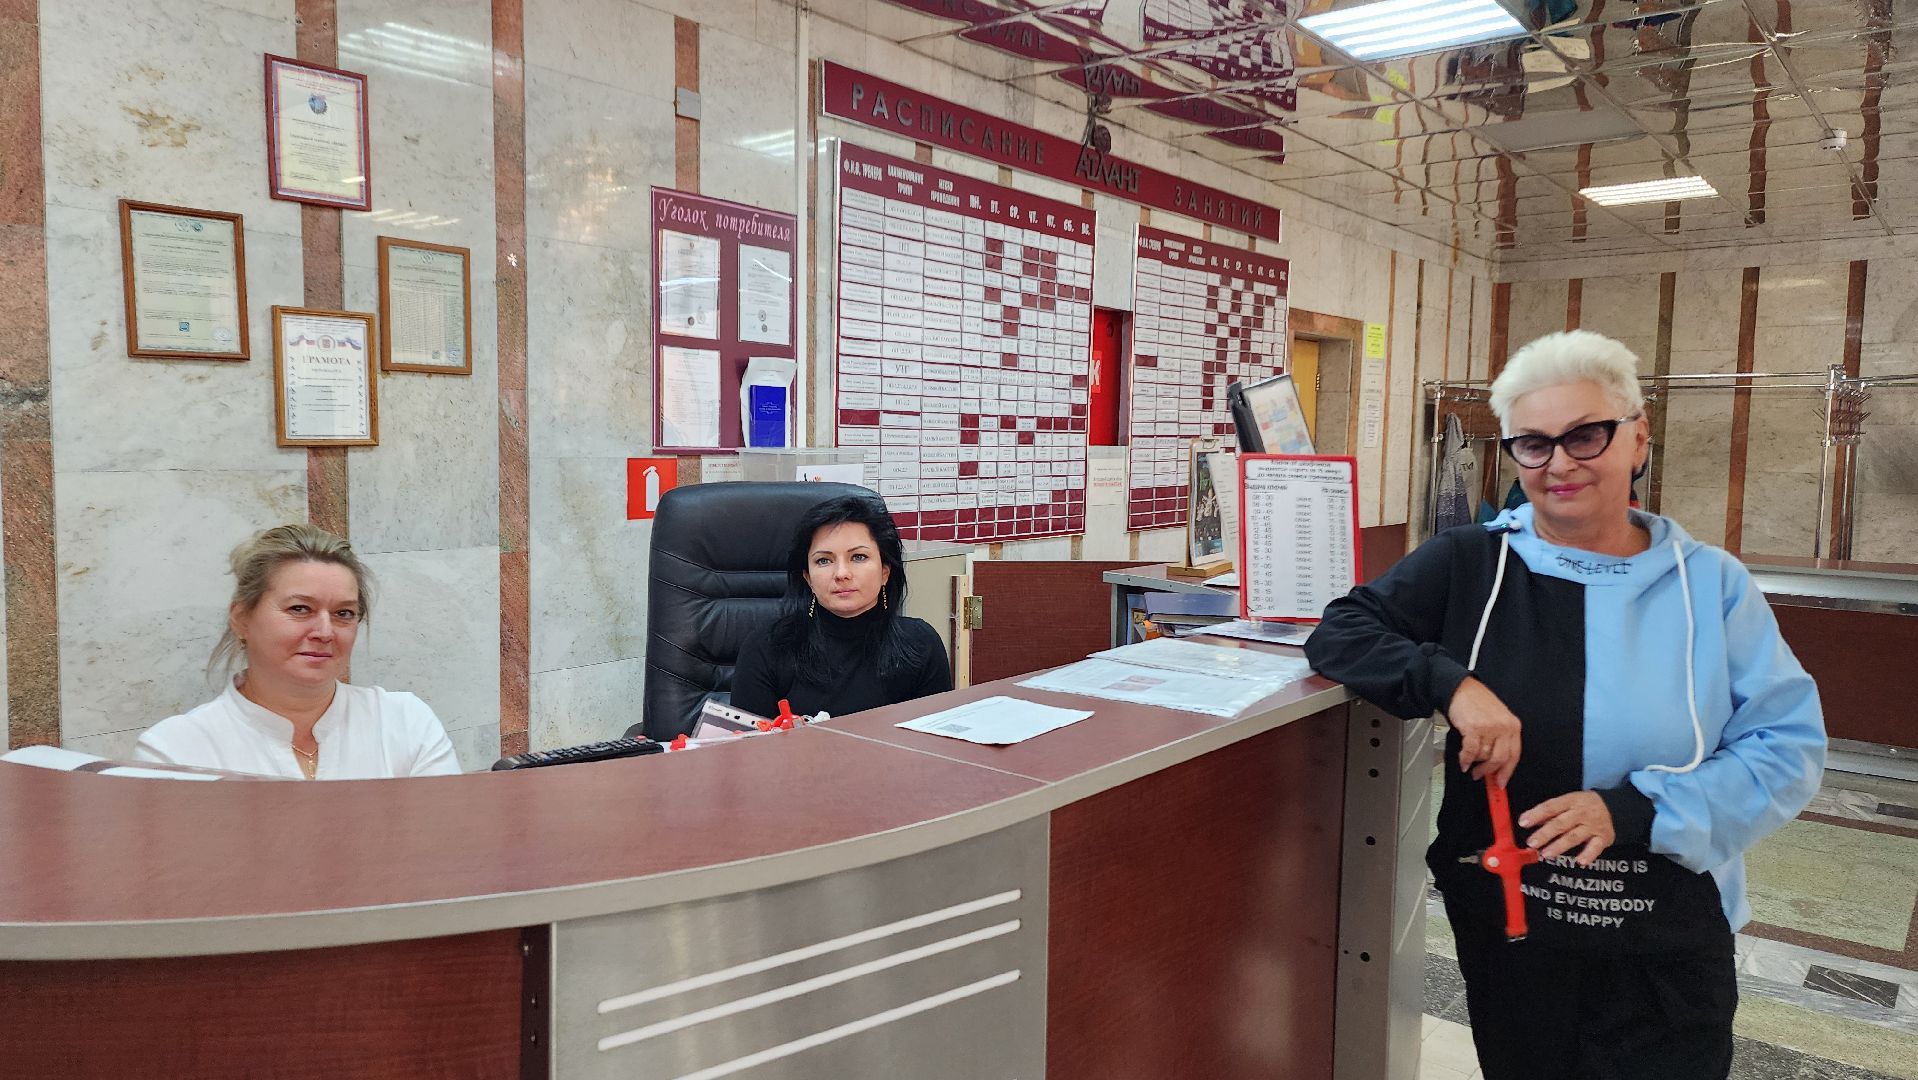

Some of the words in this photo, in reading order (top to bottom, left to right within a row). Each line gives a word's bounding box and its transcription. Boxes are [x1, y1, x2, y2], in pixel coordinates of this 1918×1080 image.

[851, 82, 1045, 165] РАСПИСАНИЕ
[1075, 150, 1141, 193] АТЛАНТ
[1174, 185, 1263, 230] ЗАНЯТИЙ
[659, 198, 709, 232] Уголок
[715, 212, 791, 242] потребителя
[1009, 204, 1020, 220] СР.
[1028, 210, 1039, 224] ЧТ.
[1063, 218, 1075, 233] СБ.
[303, 355, 351, 366] ГРАМОТА
[1633, 860, 1648, 873] IS
[1548, 873, 1624, 893] AMAZING
[1520, 884, 1551, 900] AND
[1555, 891, 1655, 912] EVERYBODY
[1547, 907, 1562, 920] IS
[1567, 911, 1624, 928] HAPPY
